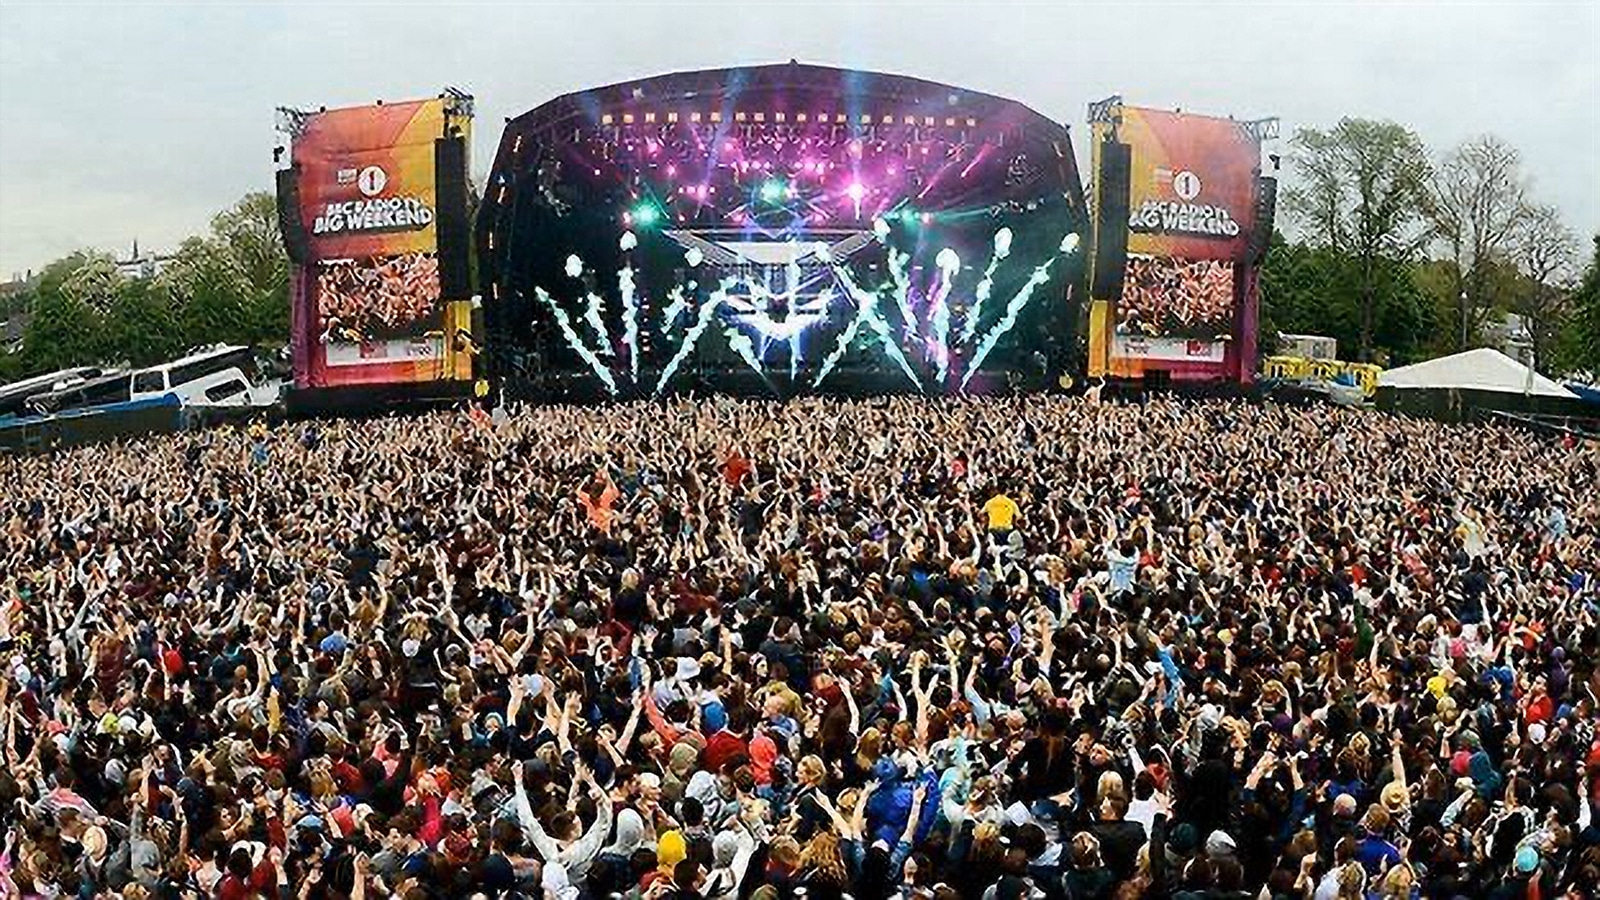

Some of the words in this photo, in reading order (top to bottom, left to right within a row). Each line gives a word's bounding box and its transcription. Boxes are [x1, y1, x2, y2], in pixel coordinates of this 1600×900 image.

[313, 215, 344, 234] BIG
[346, 206, 433, 230] WEEKEND
[1161, 212, 1240, 236] WEEKEND
